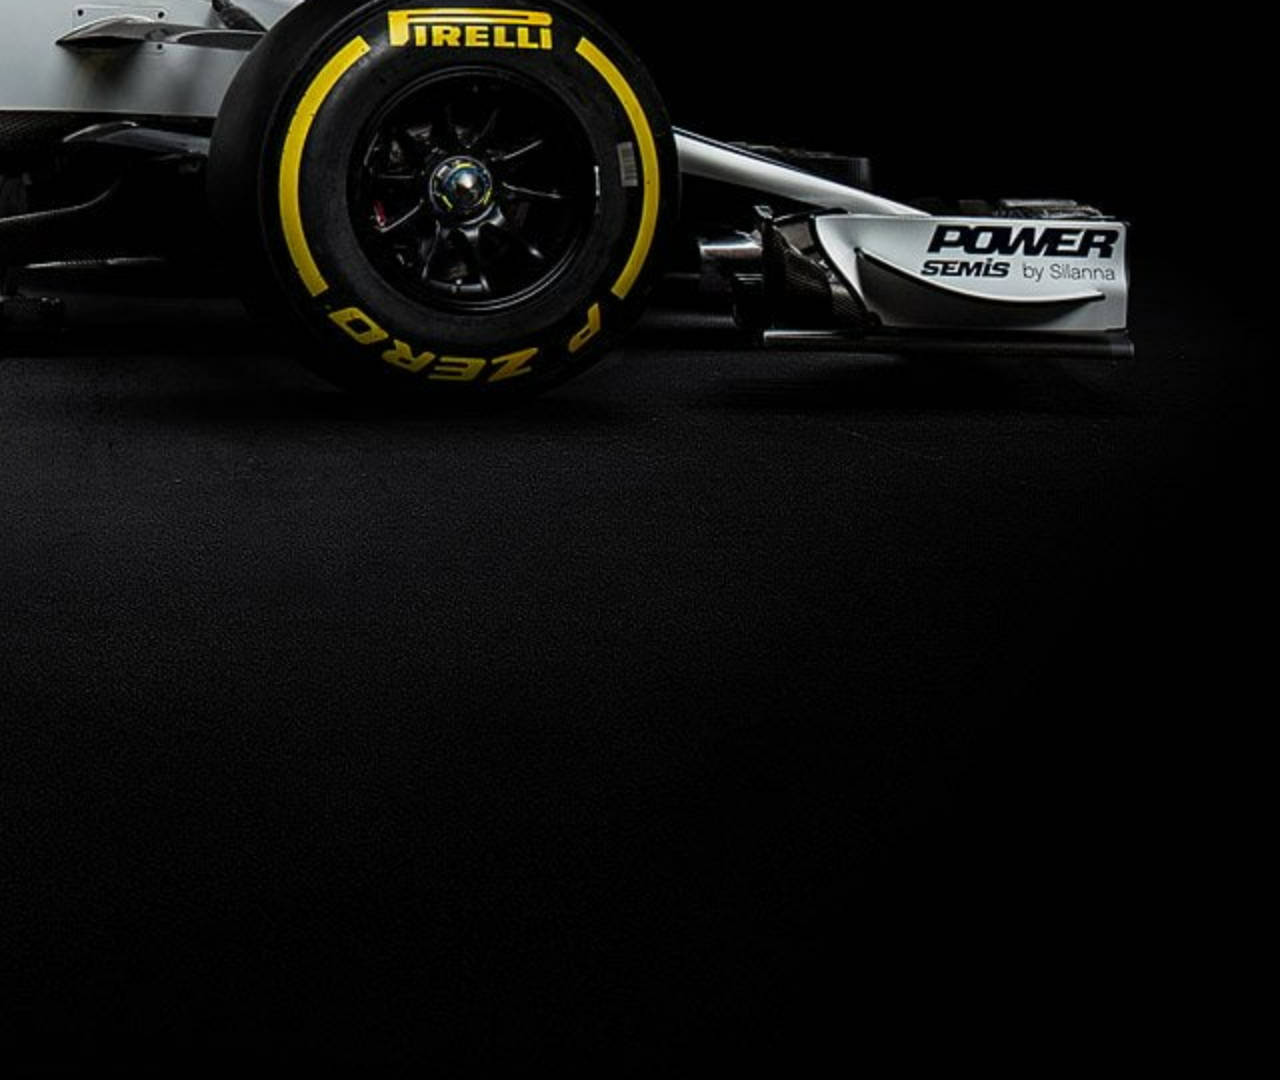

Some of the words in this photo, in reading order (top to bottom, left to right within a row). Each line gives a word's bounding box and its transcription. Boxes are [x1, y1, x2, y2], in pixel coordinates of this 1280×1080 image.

[387, 8, 553, 50] PIRELLI
[927, 224, 1120, 259] POWER
[1023, 264, 1044, 282] by
[1049, 264, 1116, 281] Silanna
[328, 306, 538, 382] ZERO
[568, 302, 601, 353] P
